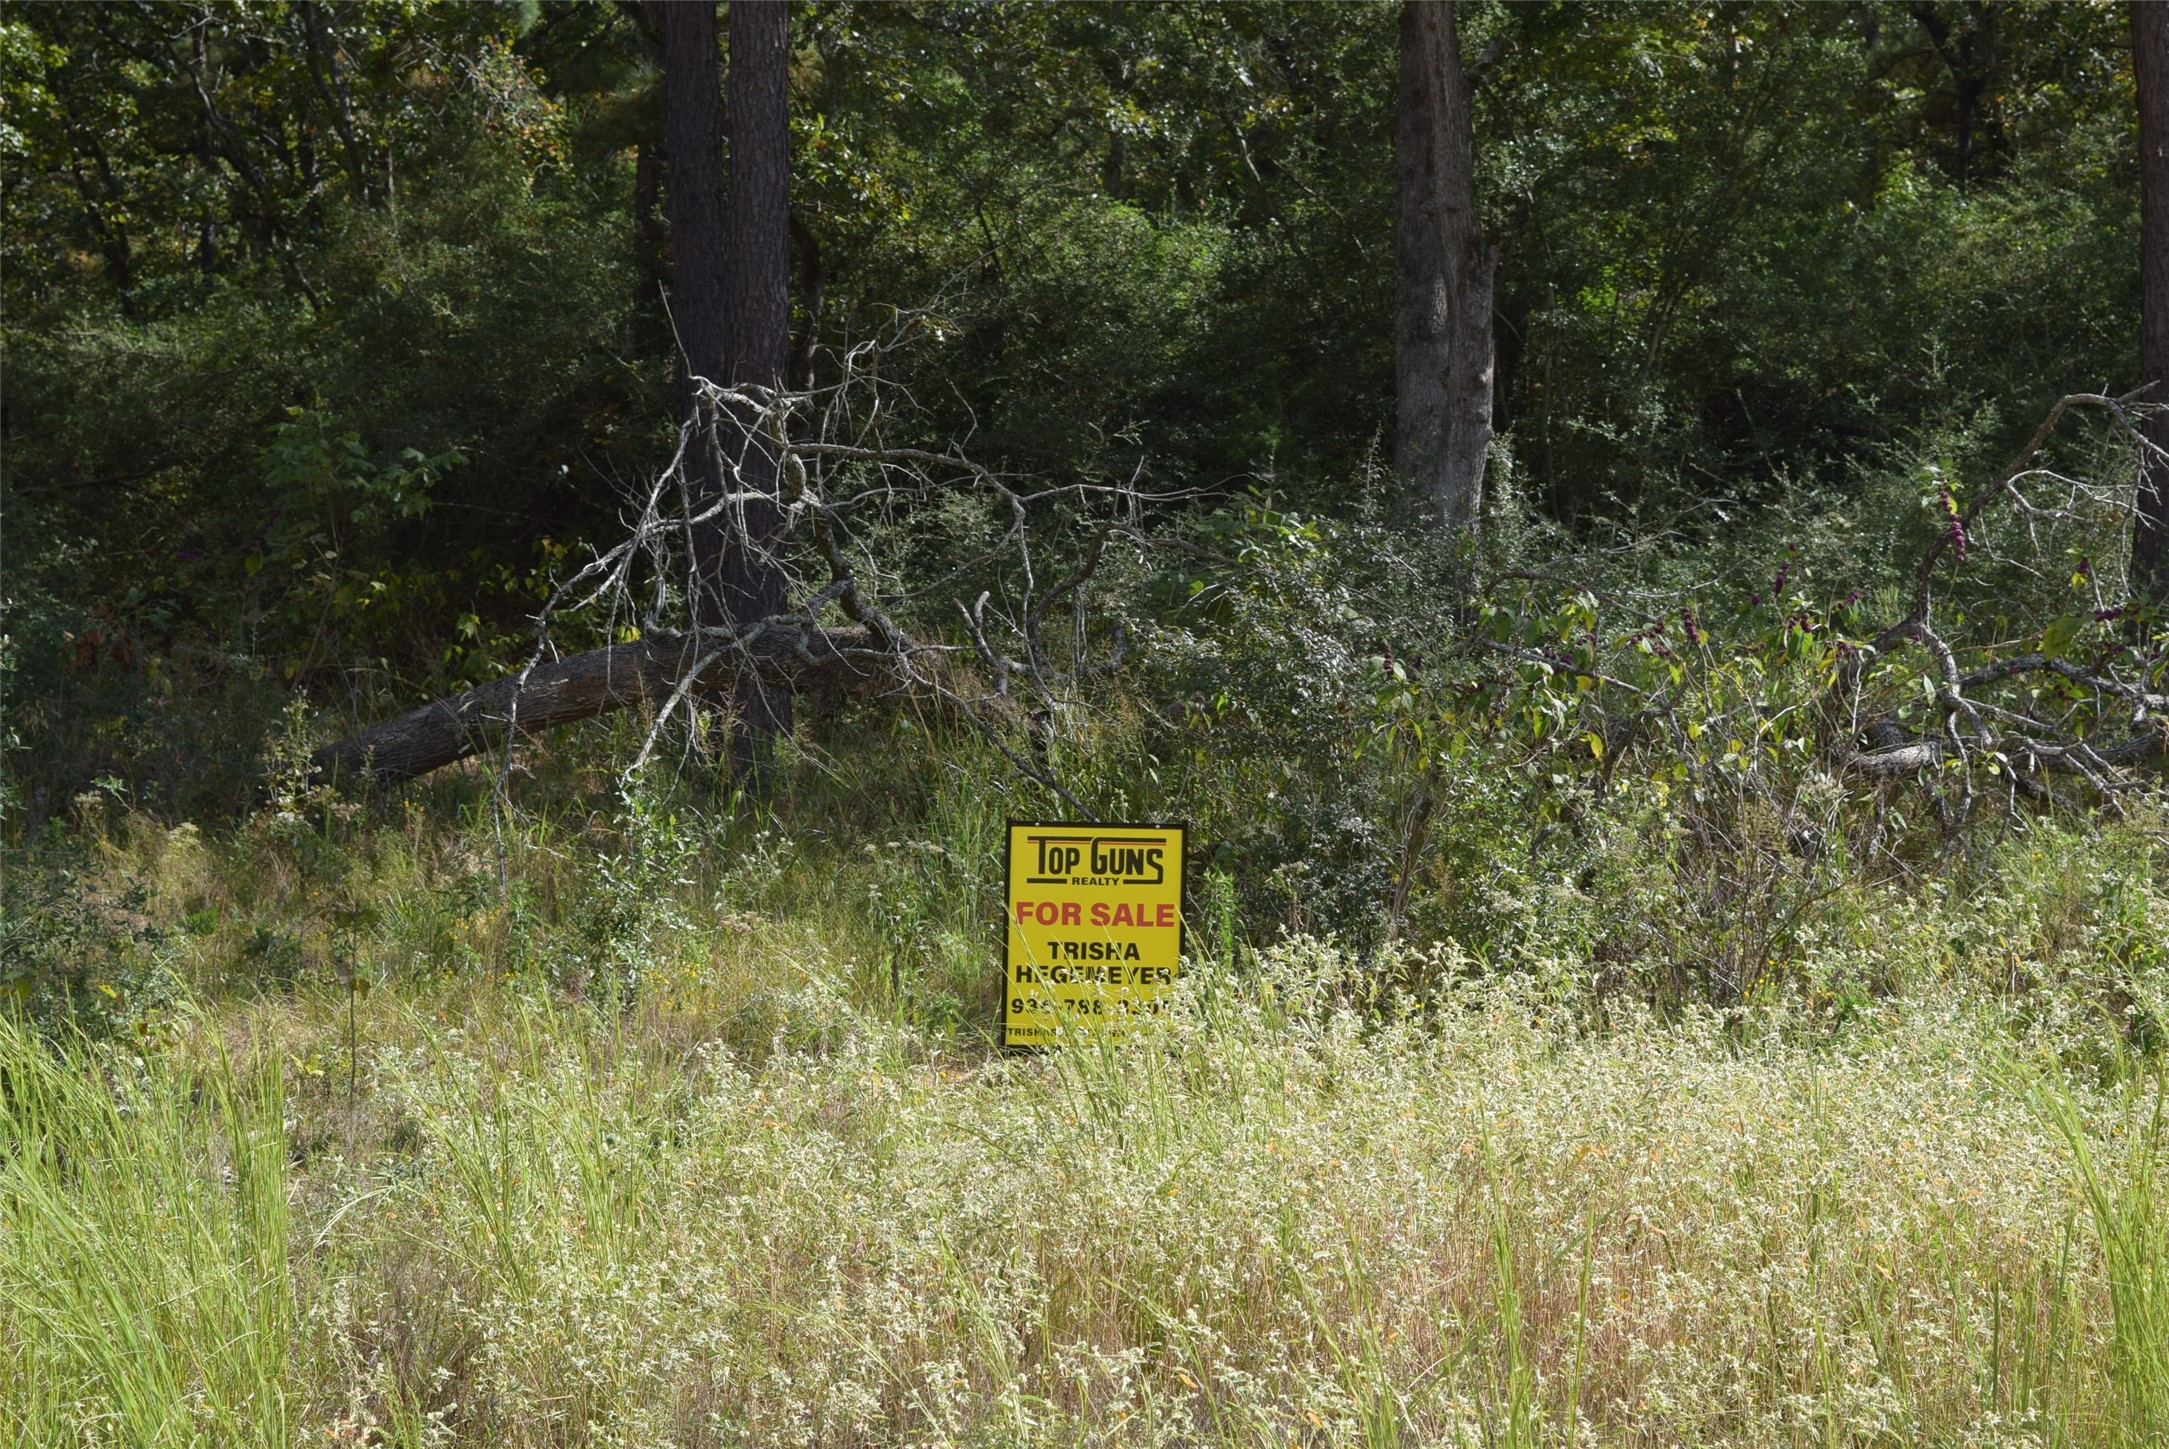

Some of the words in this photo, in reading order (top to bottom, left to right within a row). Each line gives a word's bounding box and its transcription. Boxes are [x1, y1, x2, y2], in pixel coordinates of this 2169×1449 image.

[1071, 876, 1120, 887] REALTY
[1016, 901, 1082, 927] FOR
[1090, 902, 1176, 928] SALE
[1047, 941, 1141, 961] TRISHA
[1015, 965, 1172, 985] HEGEMEYER
